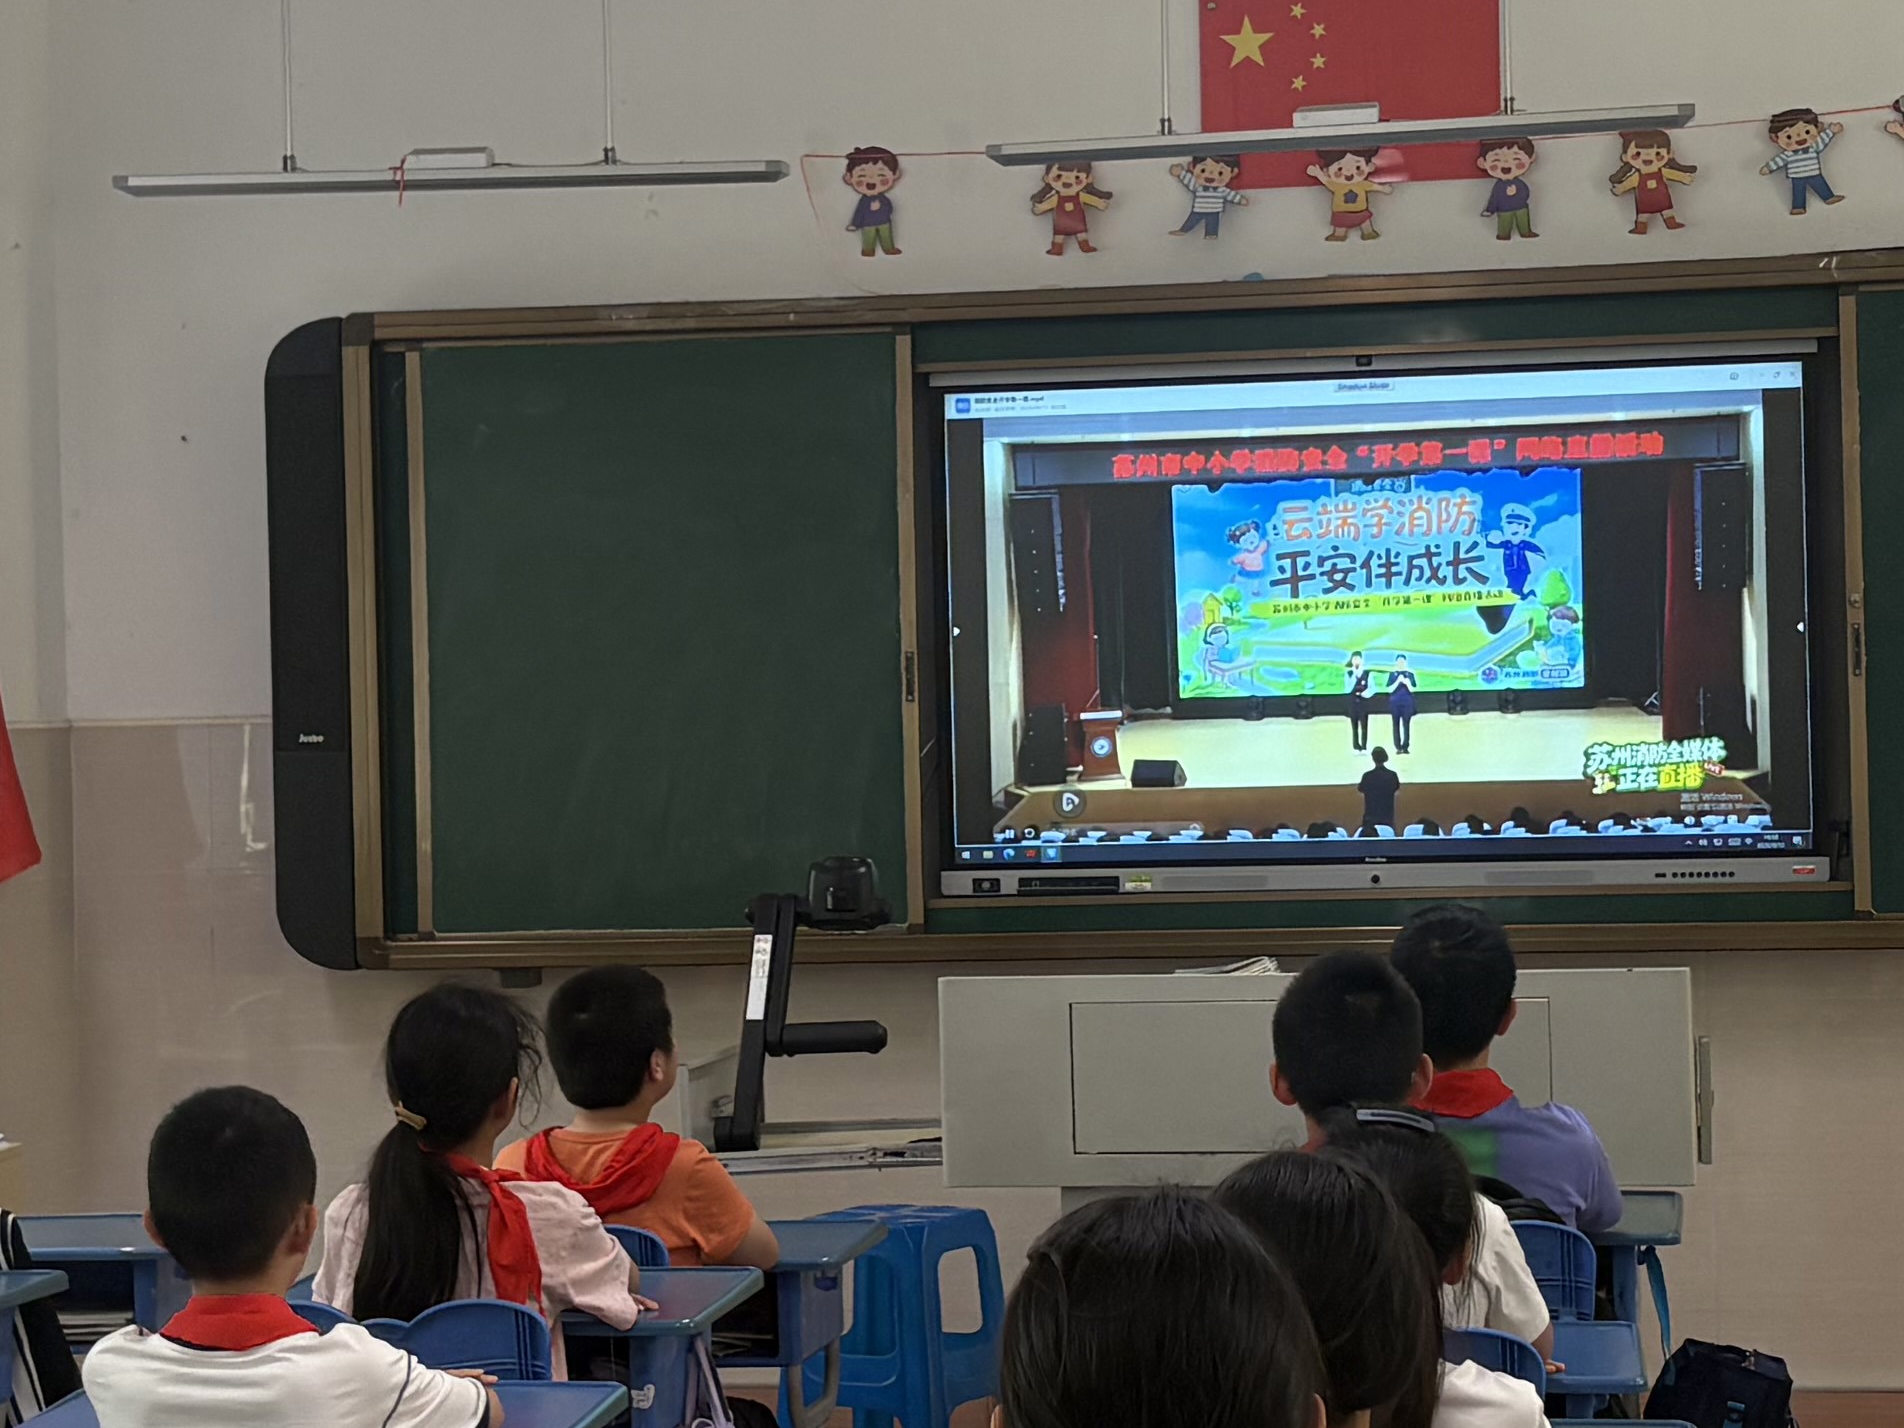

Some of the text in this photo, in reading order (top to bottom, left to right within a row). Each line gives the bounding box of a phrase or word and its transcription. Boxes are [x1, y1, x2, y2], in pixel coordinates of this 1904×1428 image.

[1279, 494, 1479, 543] 云端学消防
[1269, 540, 1491, 599] 平安伴成长
[1586, 737, 1727, 773] 苏州消防全媒体
[1616, 763, 1706, 791] 正在直播
